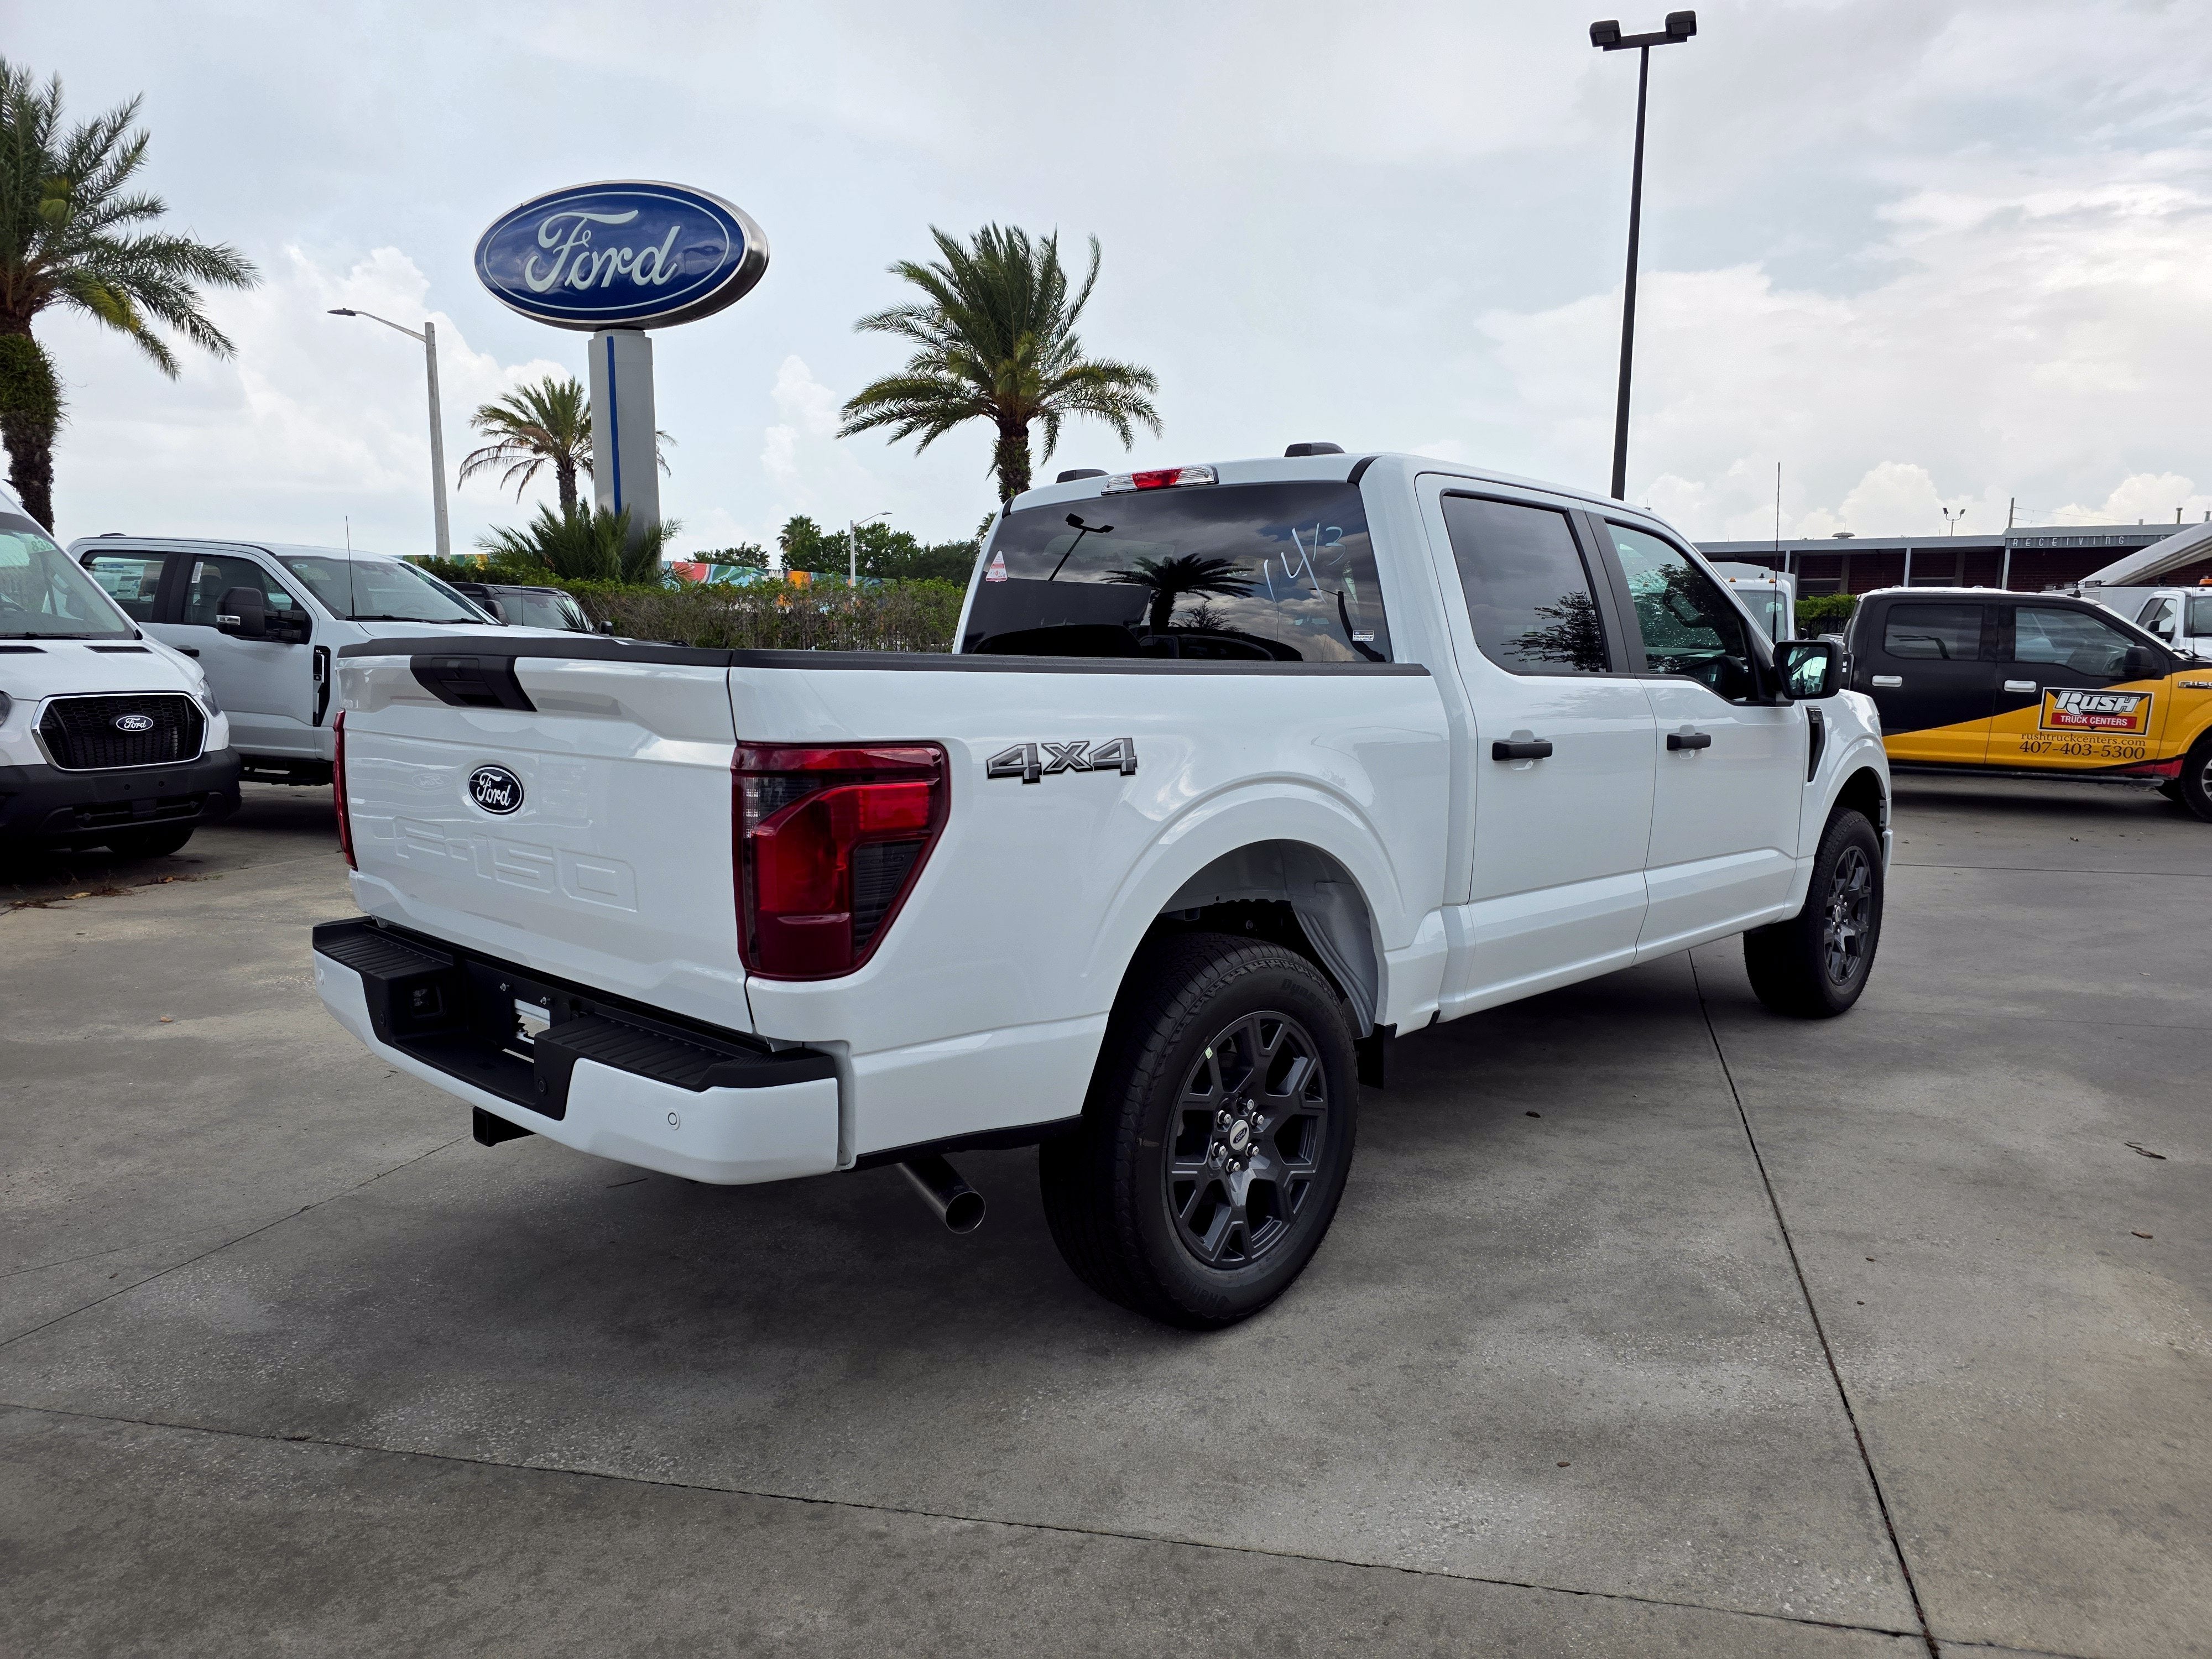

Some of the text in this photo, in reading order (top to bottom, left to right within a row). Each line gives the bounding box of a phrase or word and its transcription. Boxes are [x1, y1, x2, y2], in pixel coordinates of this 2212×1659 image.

[525, 209, 681, 294] Ford
[2012, 536, 2125, 547] RECEIVING
[2053, 691, 2141, 716] RUSH
[123, 718, 147, 729] Ford
[2060, 715, 2128, 726] TRUCK CENTERS
[2021, 732, 2146, 747] rushtruckcenters.com
[2019, 740, 2146, 760] 407-403-5300
[476, 772, 512, 806] Ford
[392, 815, 639, 913] F-150
